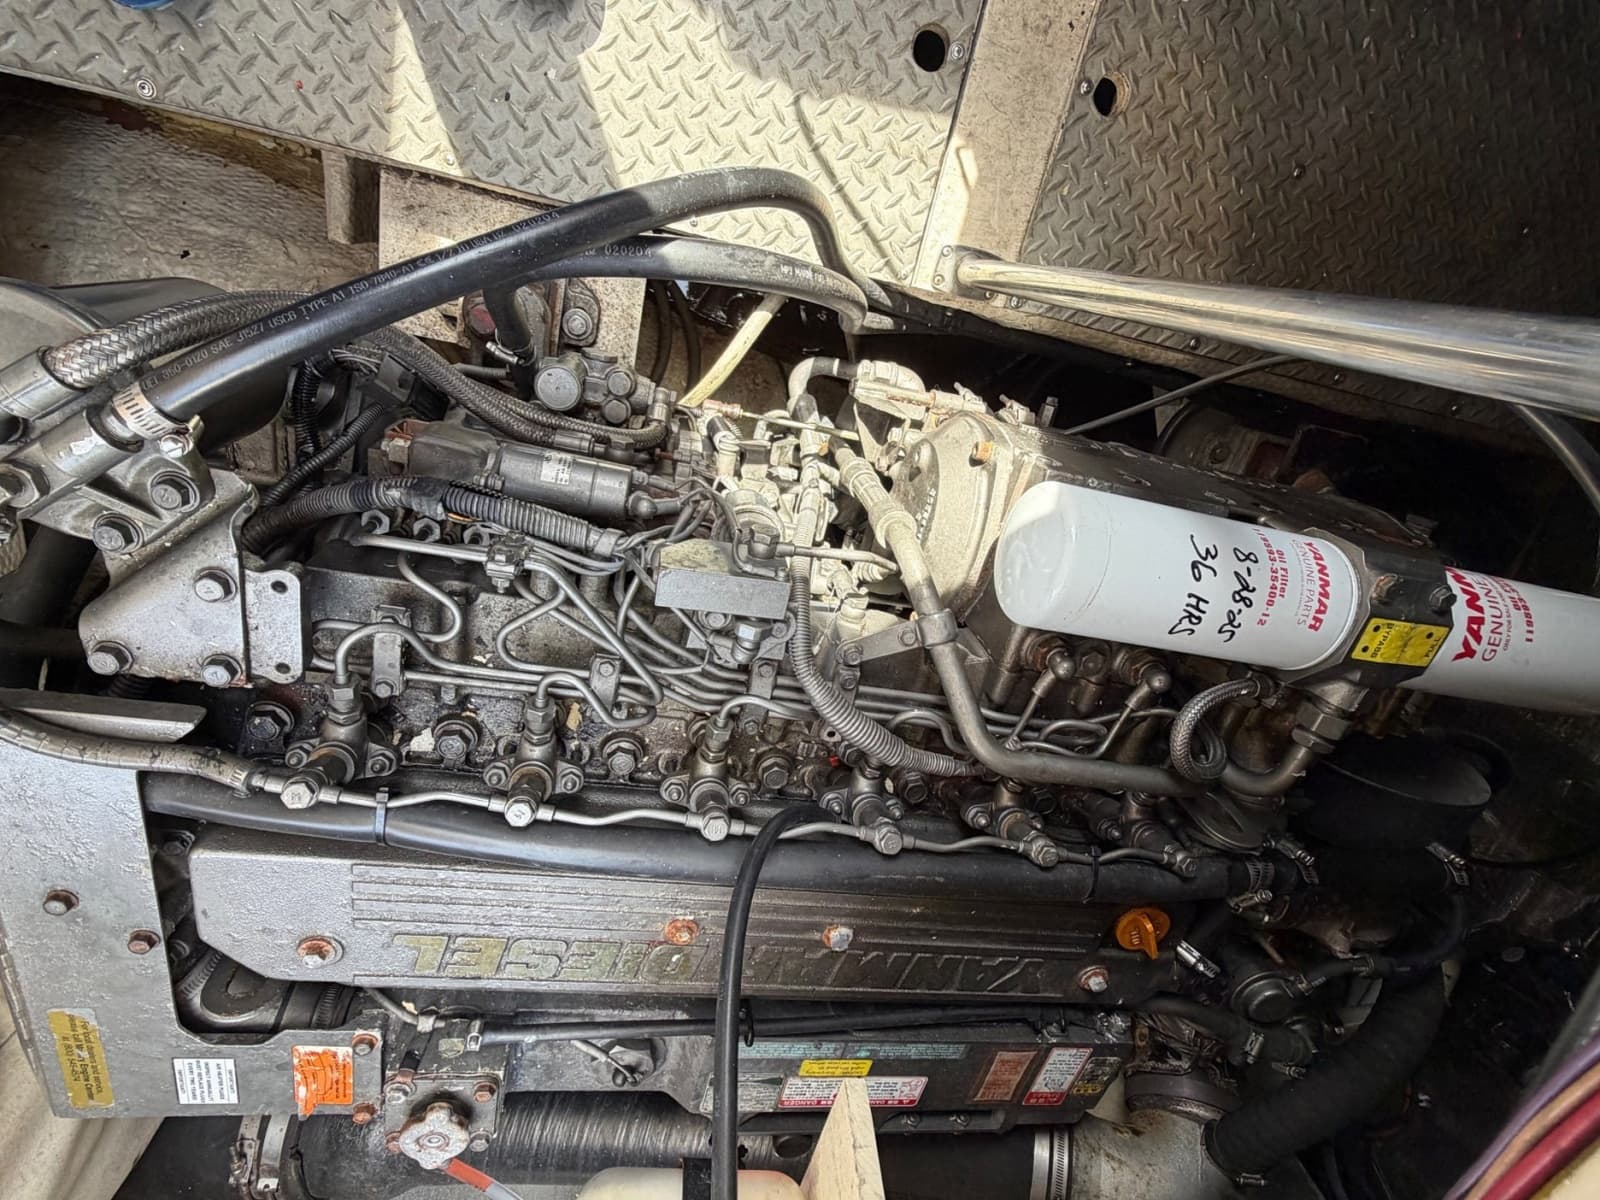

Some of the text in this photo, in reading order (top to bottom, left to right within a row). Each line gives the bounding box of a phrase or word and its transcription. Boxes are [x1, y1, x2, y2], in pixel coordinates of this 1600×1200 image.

[211, 337, 234, 354] SAE
[236, 322, 265, 343] J1527
[299, 297, 329, 316] TYPE
[332, 290, 346, 303] A1
[349, 280, 369, 296] ISO
[1168, 534, 1219, 636] 36 HRS
[1276, 549, 1288, 599] Oil Filter
[1303, 541, 1331, 632] YANMAR
[1297, 590, 1316, 626] PARTS
[392, 934, 708, 983] DIESEL
